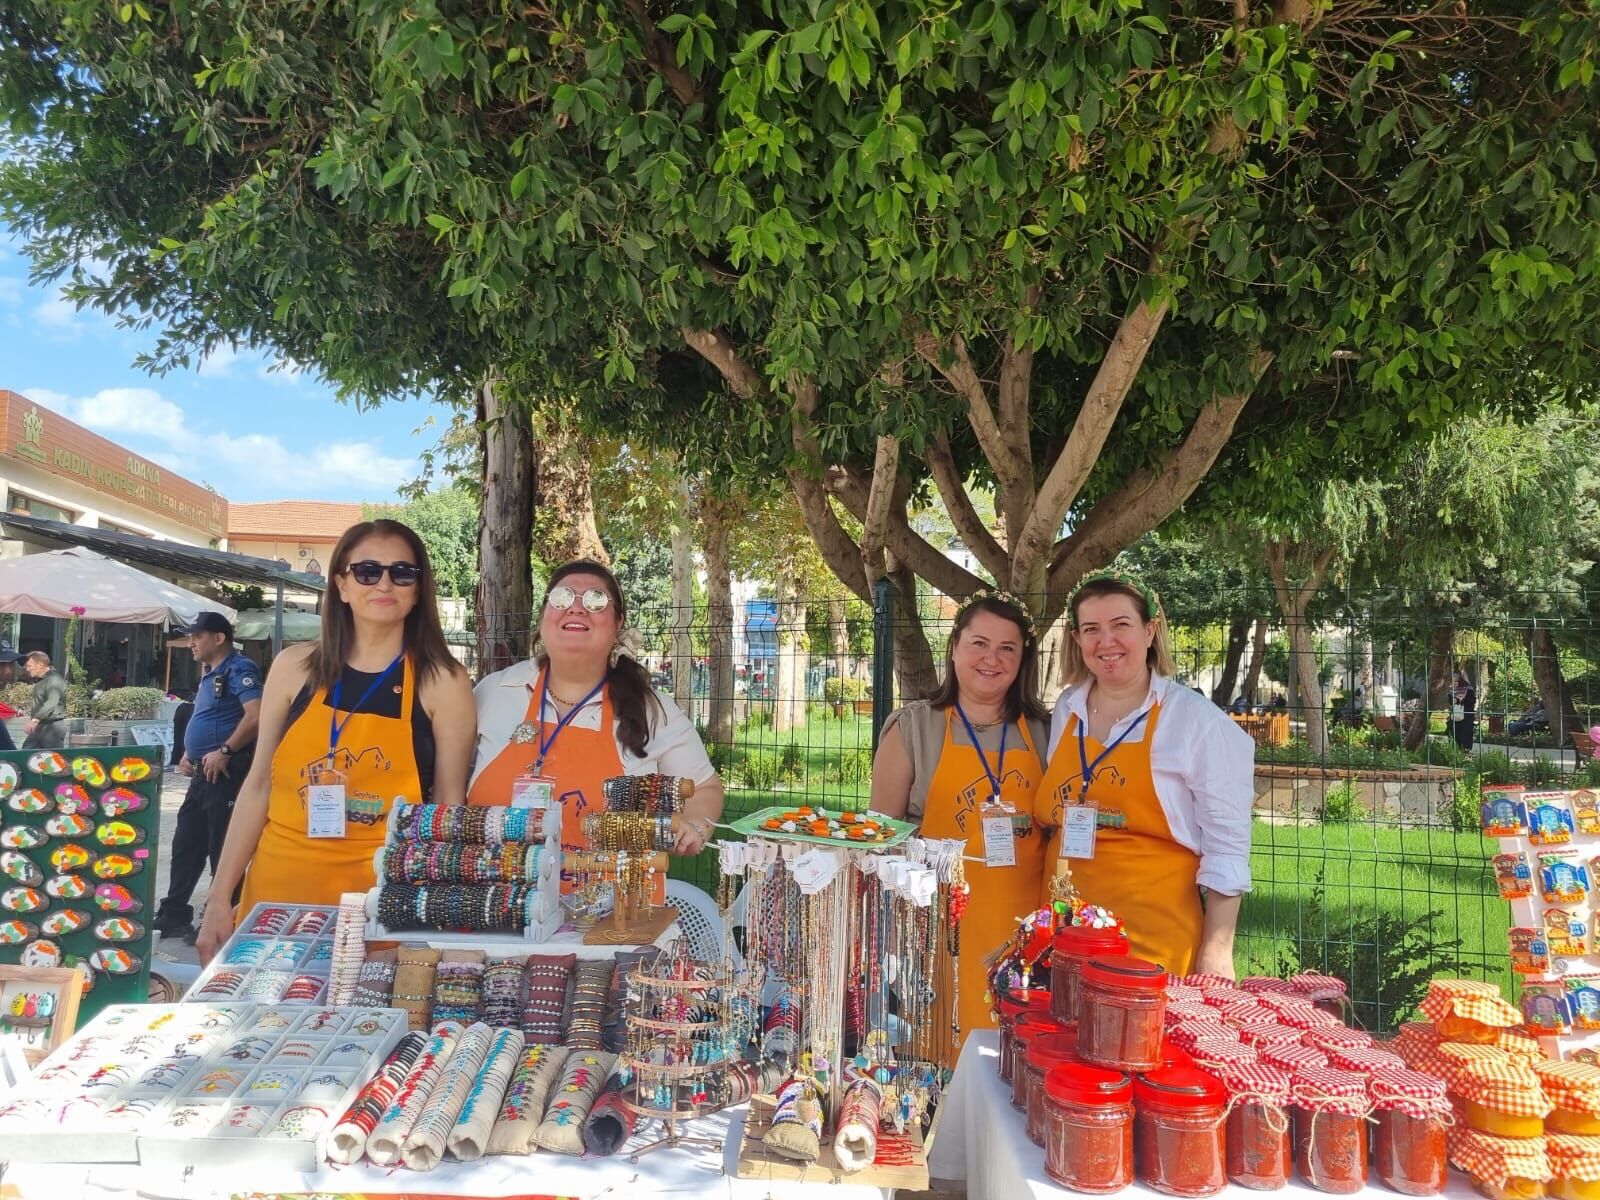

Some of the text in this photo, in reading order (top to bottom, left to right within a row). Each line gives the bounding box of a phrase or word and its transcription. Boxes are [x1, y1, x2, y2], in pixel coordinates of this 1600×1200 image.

[53, 447, 93, 480] KADIN
[127, 456, 161, 485] ADANA
[353, 790, 380, 800] Seyhan
[560, 842, 583, 852] yhan
